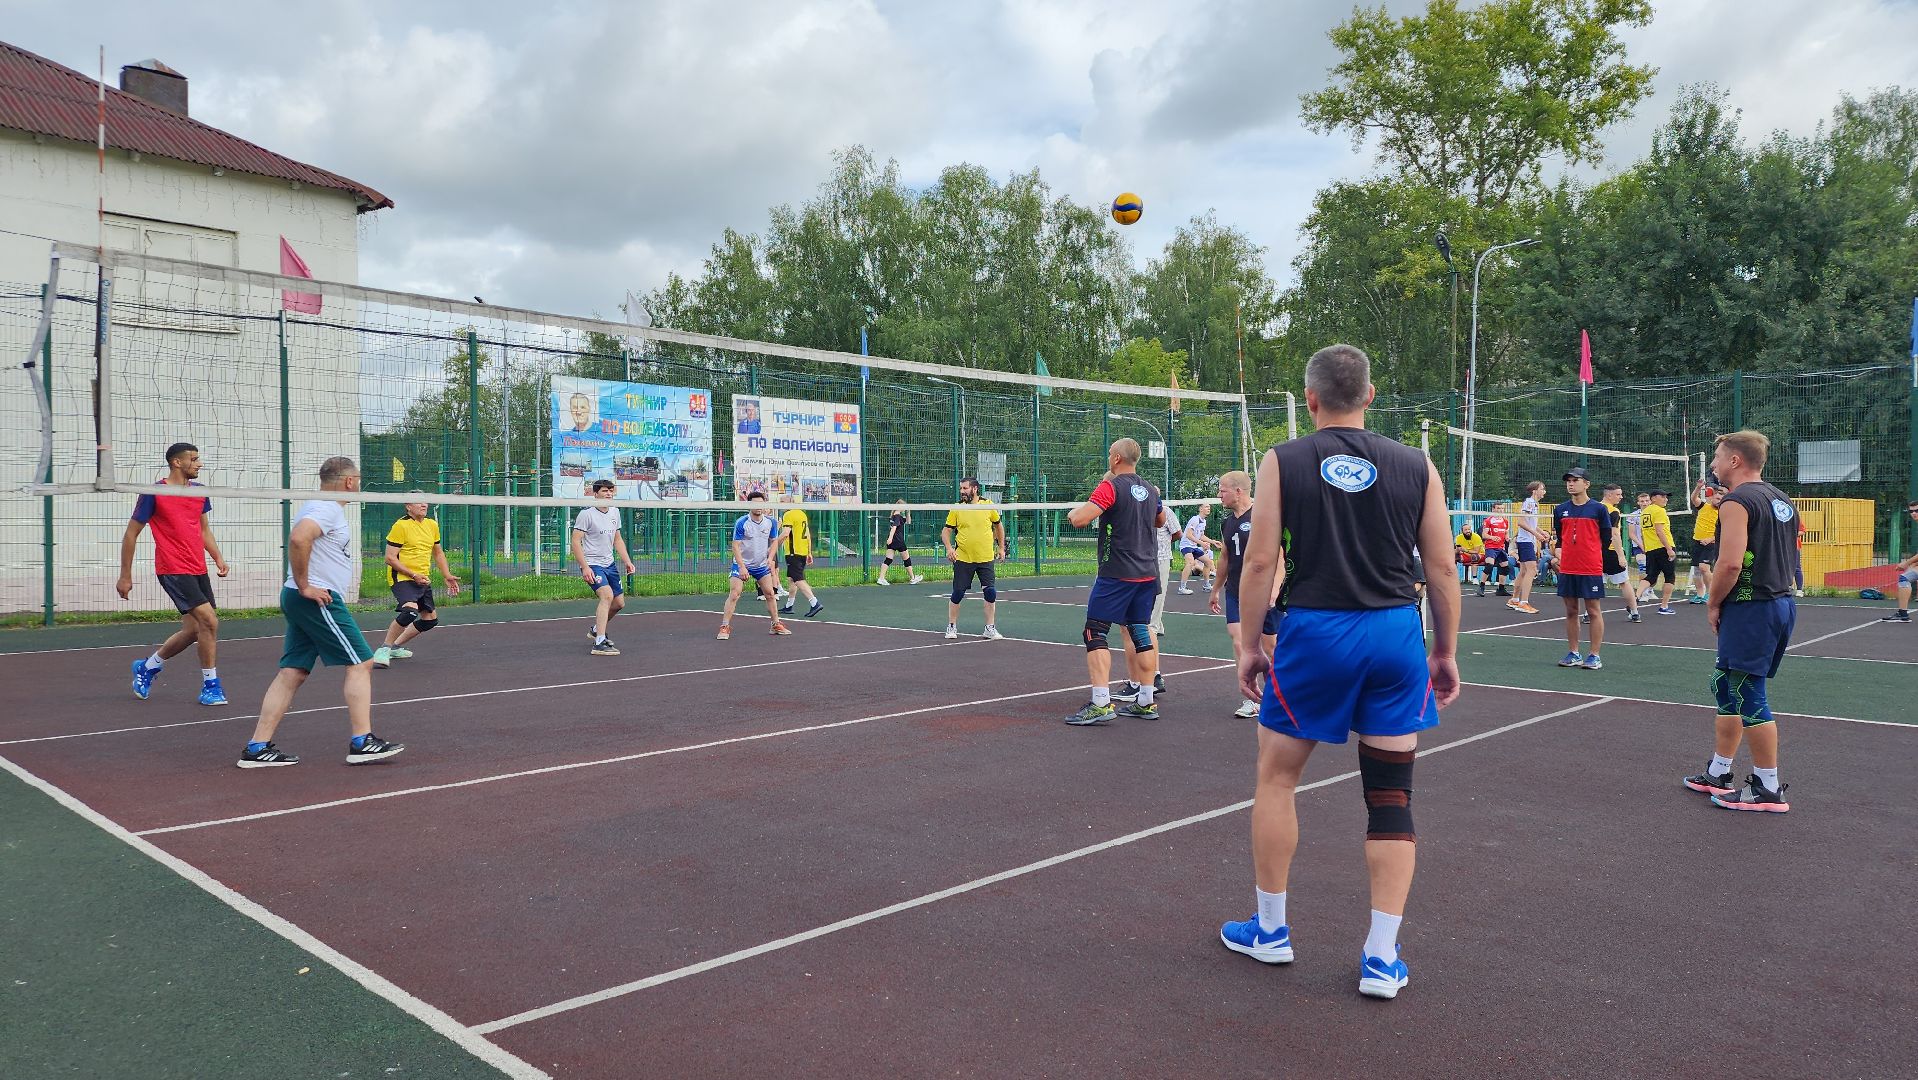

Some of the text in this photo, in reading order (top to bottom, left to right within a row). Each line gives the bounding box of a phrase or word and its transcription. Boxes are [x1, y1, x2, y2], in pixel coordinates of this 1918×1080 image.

[625, 393, 667, 410] ТУРНИР
[602, 418, 689, 438] ПО ВОЛЕЙБОЛУ
[773, 411, 826, 427] ТУРНИР
[748, 436, 849, 454] ПО ВОЛЕЙБОЛУ
[801, 520, 807, 539] 2
[1231, 532, 1241, 556] 1
